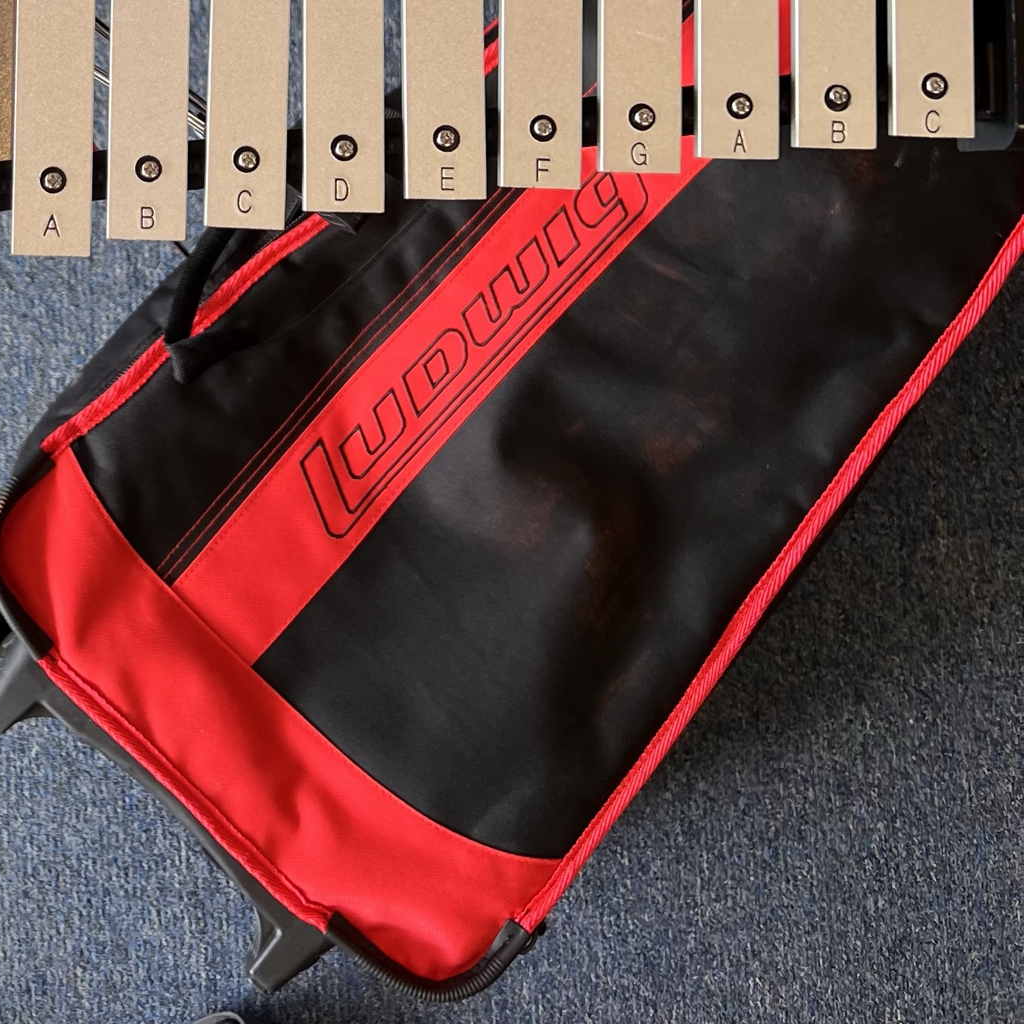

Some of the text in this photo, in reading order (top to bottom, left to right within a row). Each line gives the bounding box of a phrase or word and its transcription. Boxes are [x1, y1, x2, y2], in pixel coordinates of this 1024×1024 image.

[830, 119, 847, 145] B
[924, 109, 942, 134] C
[732, 127, 748, 154] A
[630, 141, 648, 167] G
[440, 166, 456, 192] E
[533, 157, 552, 184] F
[236, 188, 253, 215] C
[334, 177, 350, 202] D
[42, 213, 61, 239] A
[139, 205, 155, 230] B
